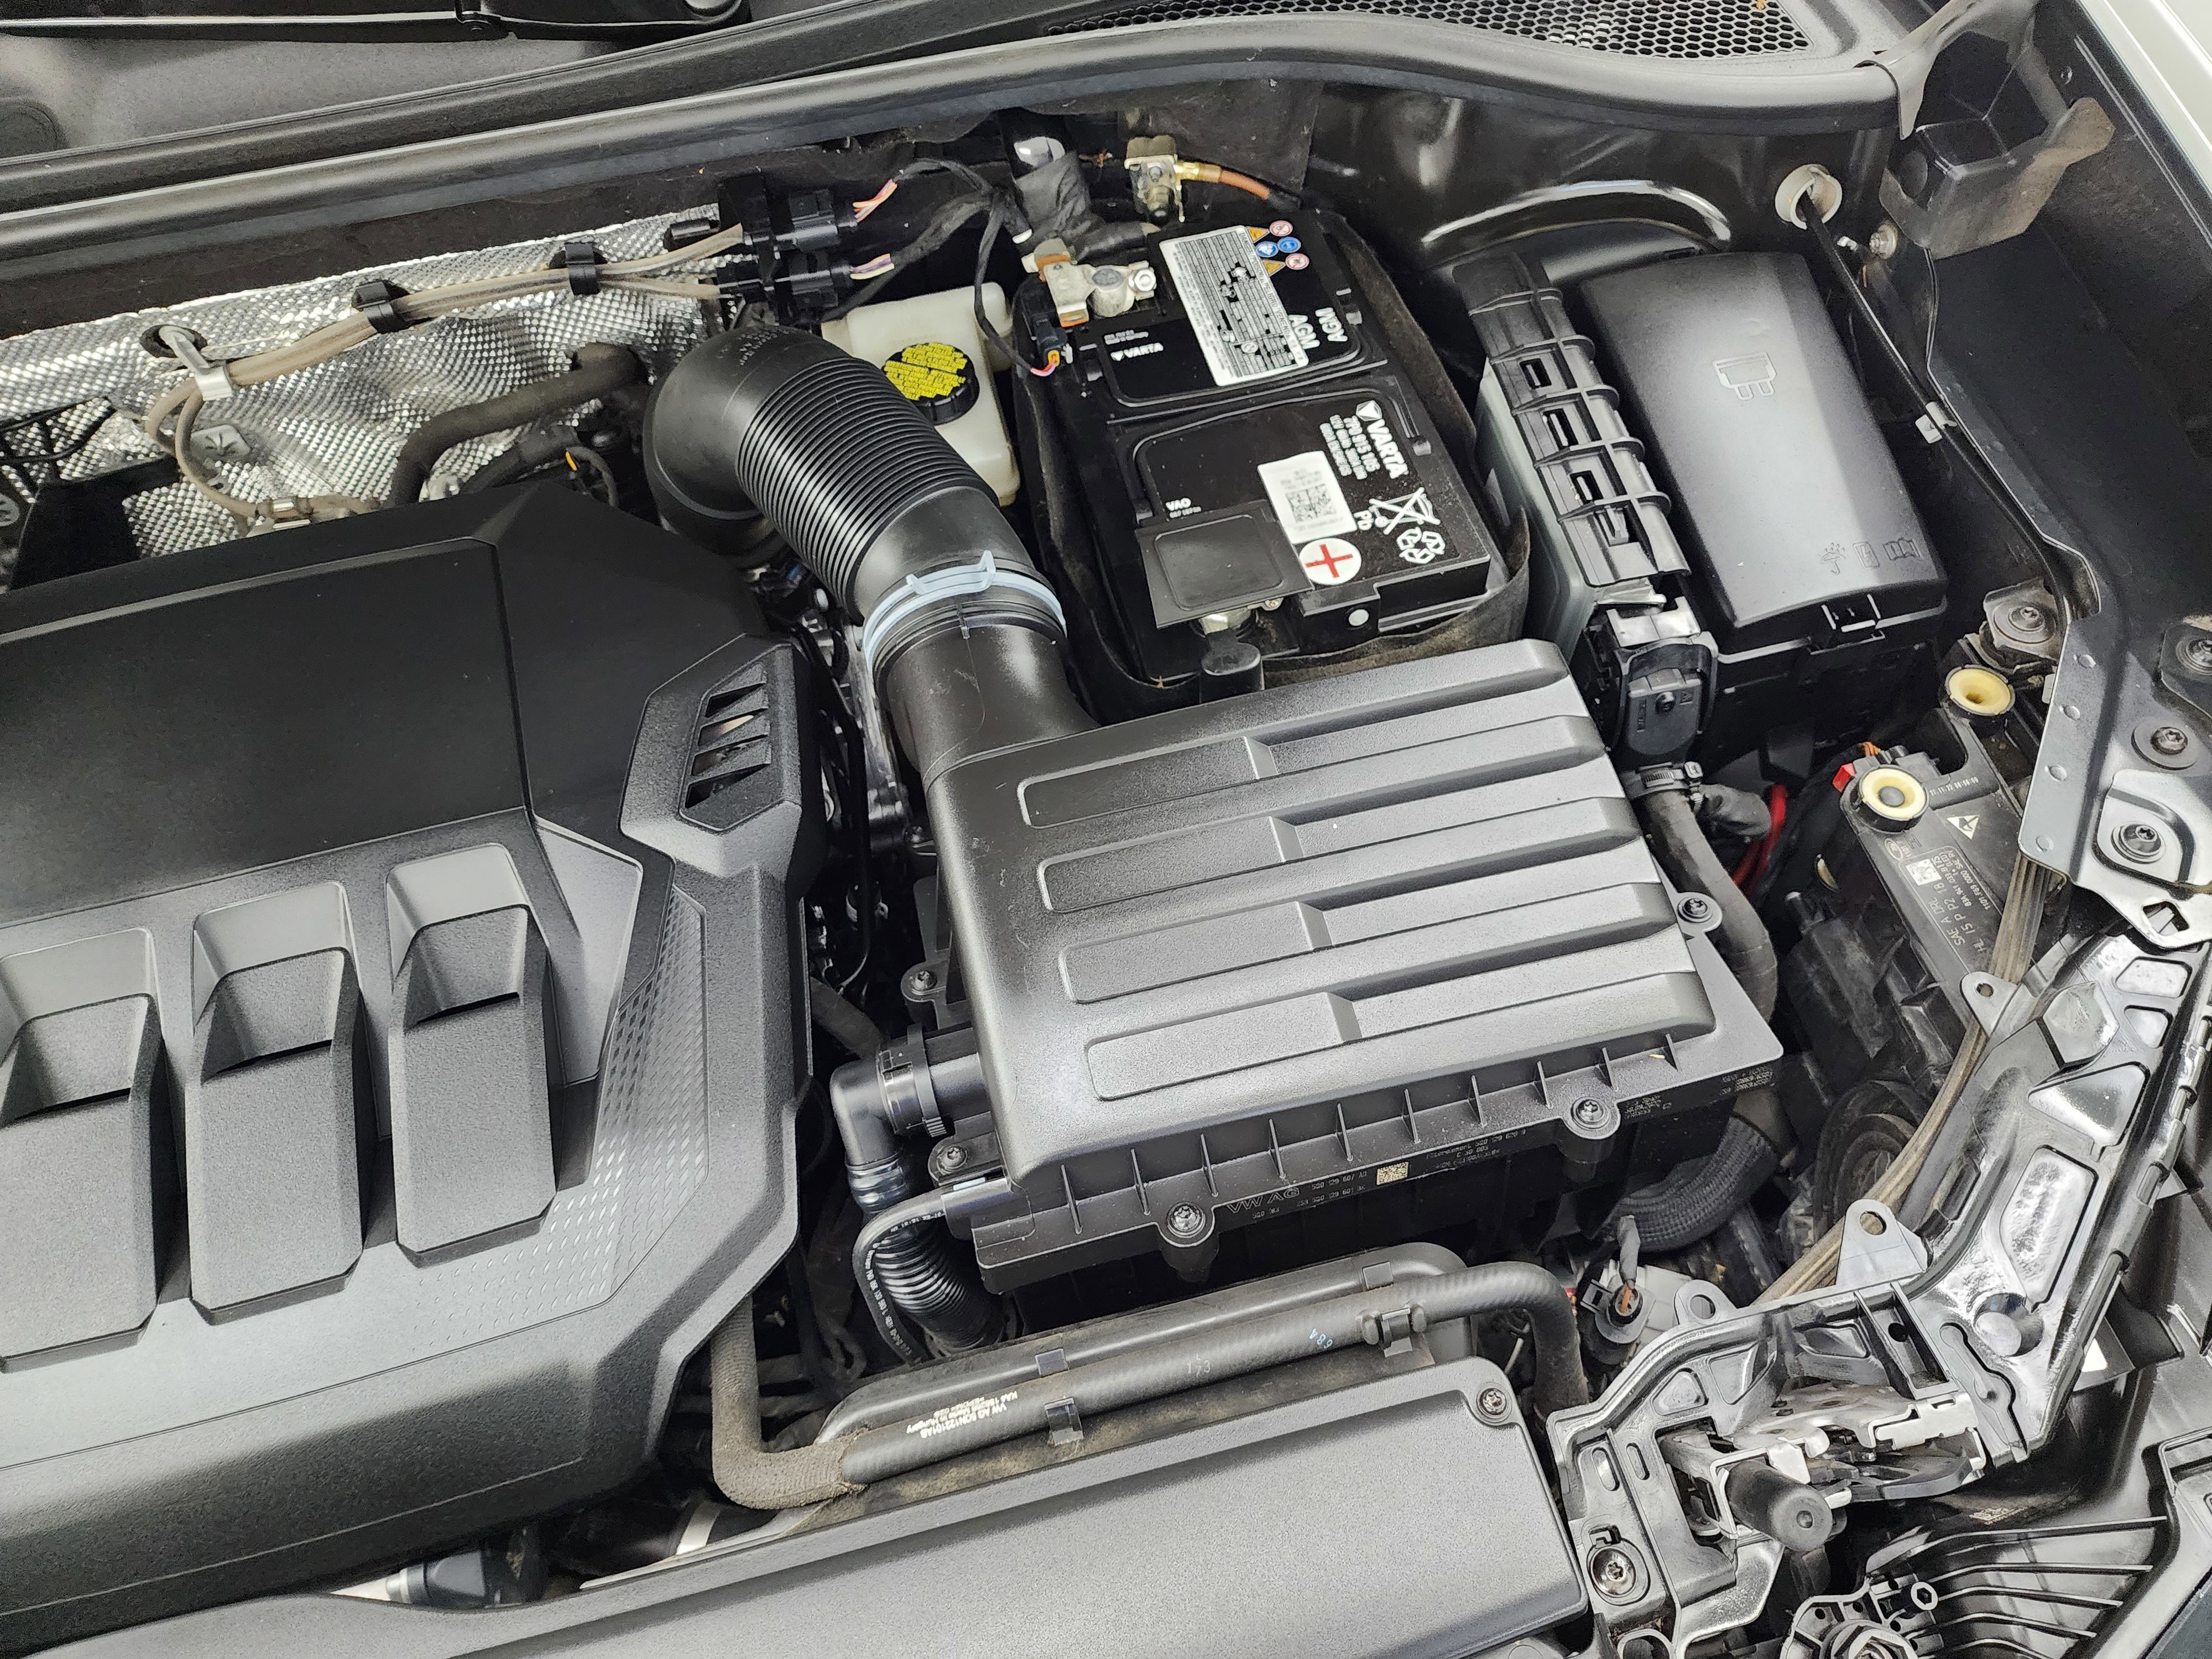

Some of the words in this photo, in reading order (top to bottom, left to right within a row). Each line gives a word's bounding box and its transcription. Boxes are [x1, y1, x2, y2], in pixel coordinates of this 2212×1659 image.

[1287, 314, 1321, 349] AGM
[1314, 306, 1349, 341] AGM
[1123, 342, 1163, 357] VARTA
[1350, 433, 1373, 455] 915
[1366, 418, 1410, 480] VARTA
[1352, 509, 1376, 531] Pb
[1927, 896, 1945, 914] DRL
[1943, 897, 1959, 911] P2
[1945, 926, 1965, 945] SAE
[1973, 937, 1987, 952] HL
[1227, 1195, 1262, 1214] VW
[1267, 1186, 1300, 1203] AG
[1308, 1328, 1332, 1348] 684
[991, 1402, 1007, 1414] VW
